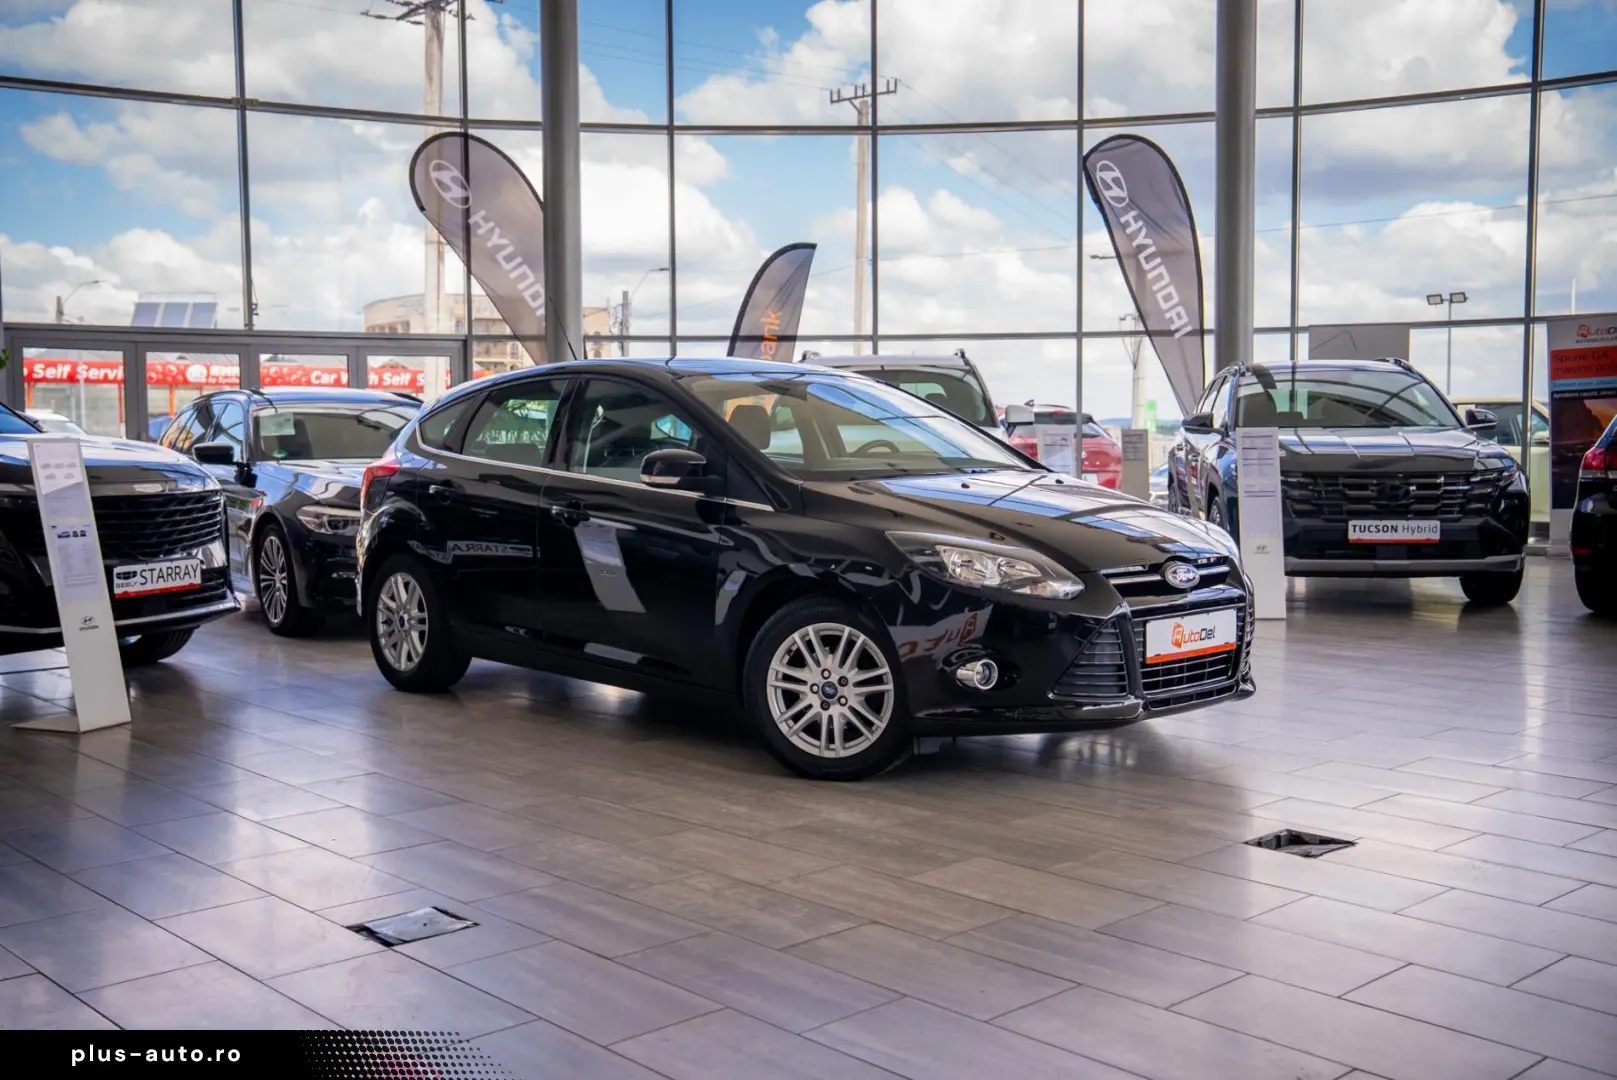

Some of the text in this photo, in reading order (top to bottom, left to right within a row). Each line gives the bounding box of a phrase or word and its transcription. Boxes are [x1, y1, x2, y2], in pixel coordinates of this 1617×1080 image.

[468, 209, 545, 317] HYUND
[1120, 210, 1193, 340] HYUNDAI
[32, 363, 71, 379] Self
[75, 364, 123, 380] Servi
[310, 370, 337, 385] Car
[382, 372, 410, 386] Self
[1351, 523, 1438, 535] TUCSON Hybrid
[139, 563, 199, 586] STARRAY
[1171, 621, 1216, 649] AutoDel
